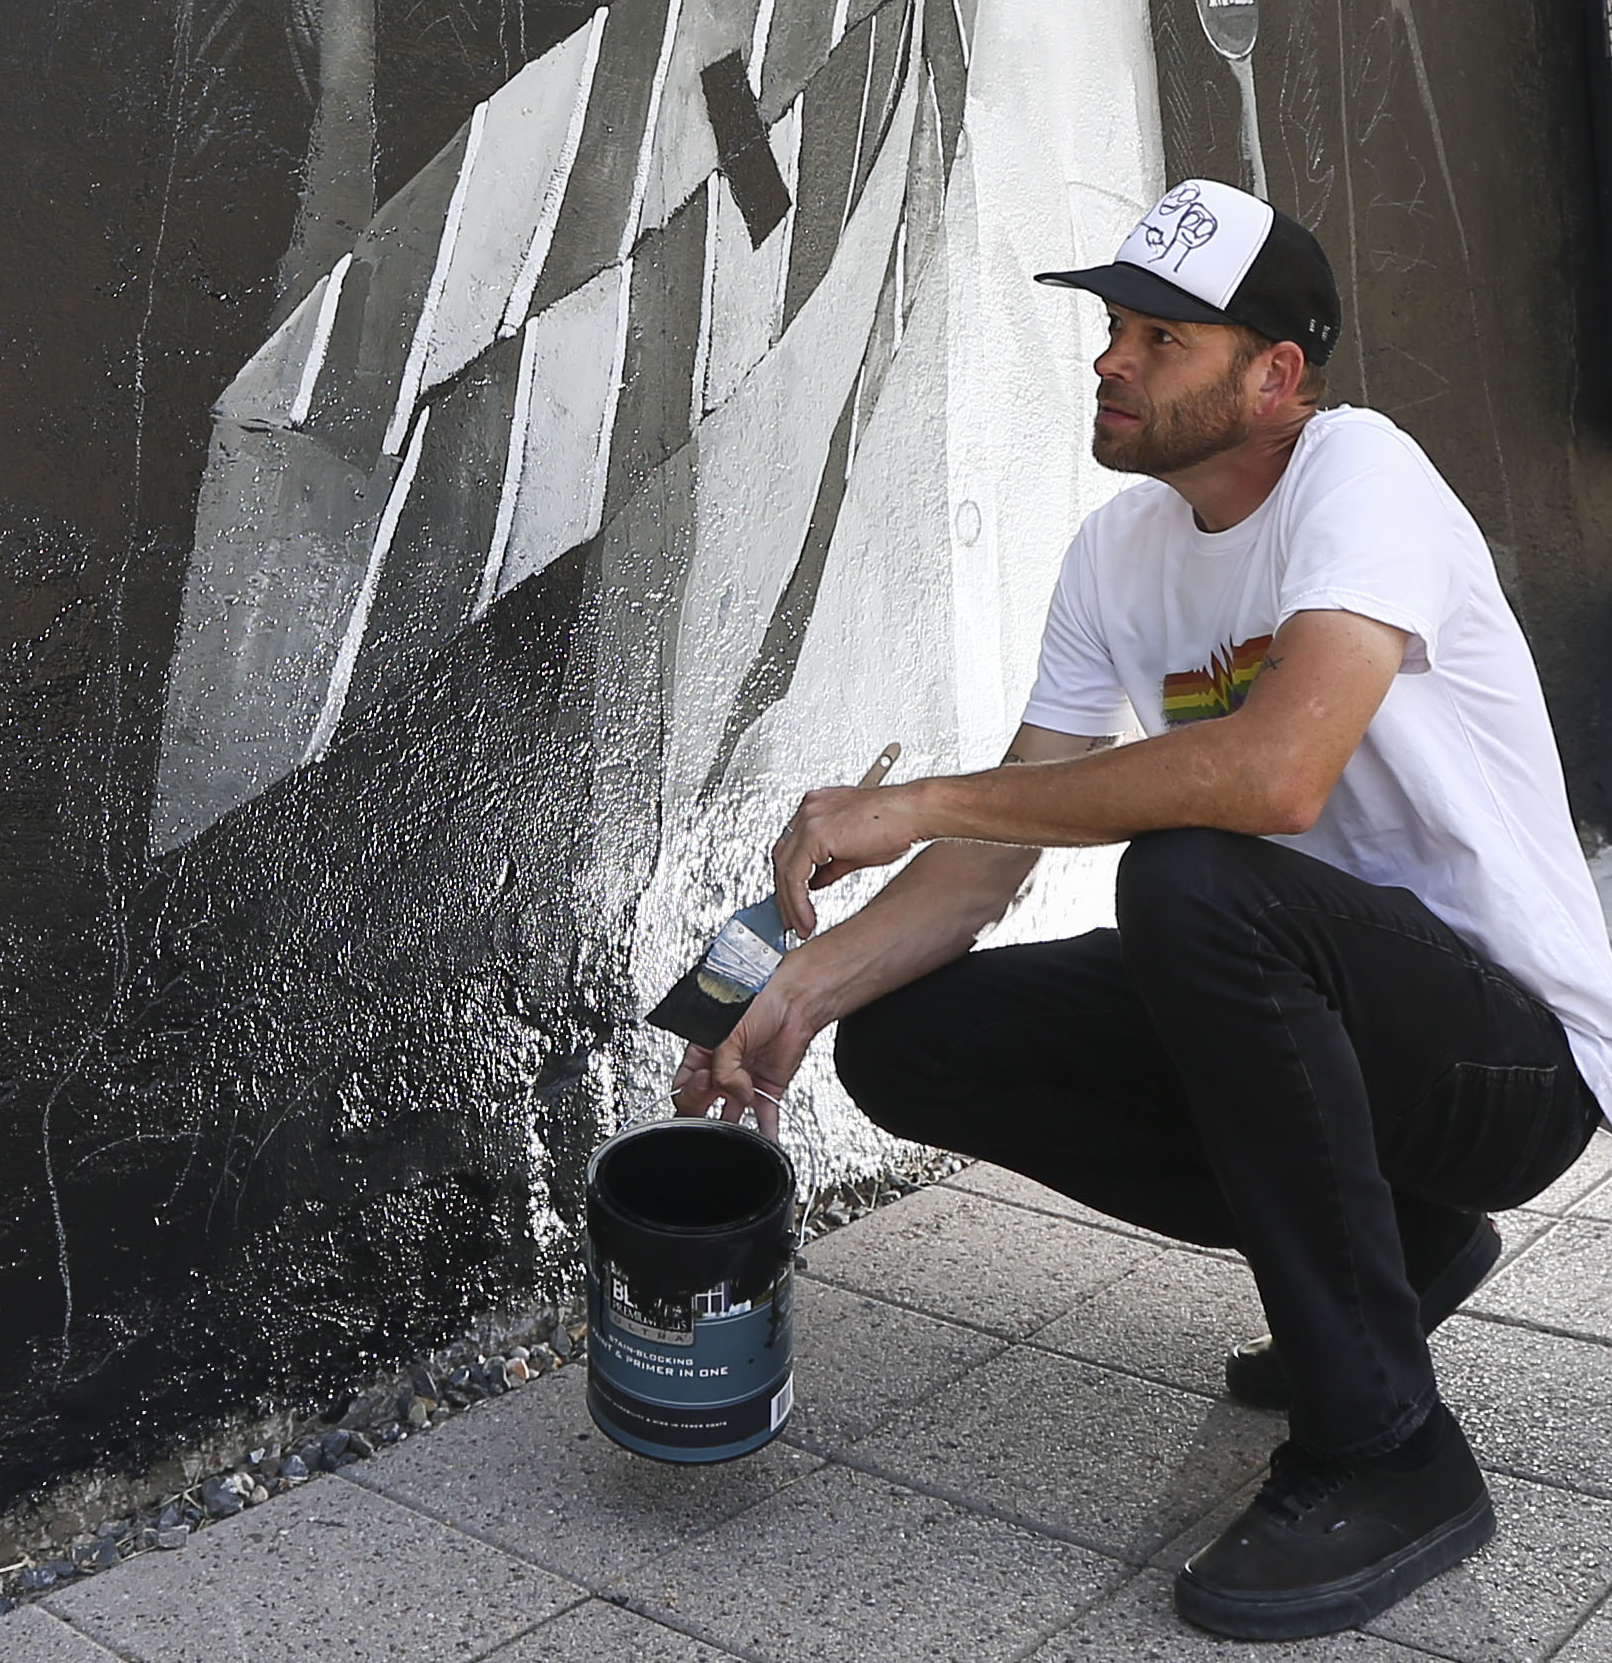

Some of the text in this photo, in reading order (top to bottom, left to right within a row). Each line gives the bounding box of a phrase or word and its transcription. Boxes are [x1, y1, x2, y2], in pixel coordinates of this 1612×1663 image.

[609, 1334, 694, 1366] STAIN-BLOCKING
[626, 1355, 674, 1377] PRIMER
[679, 1368, 694, 1378] IN
[699, 1366, 729, 1378] ONE
